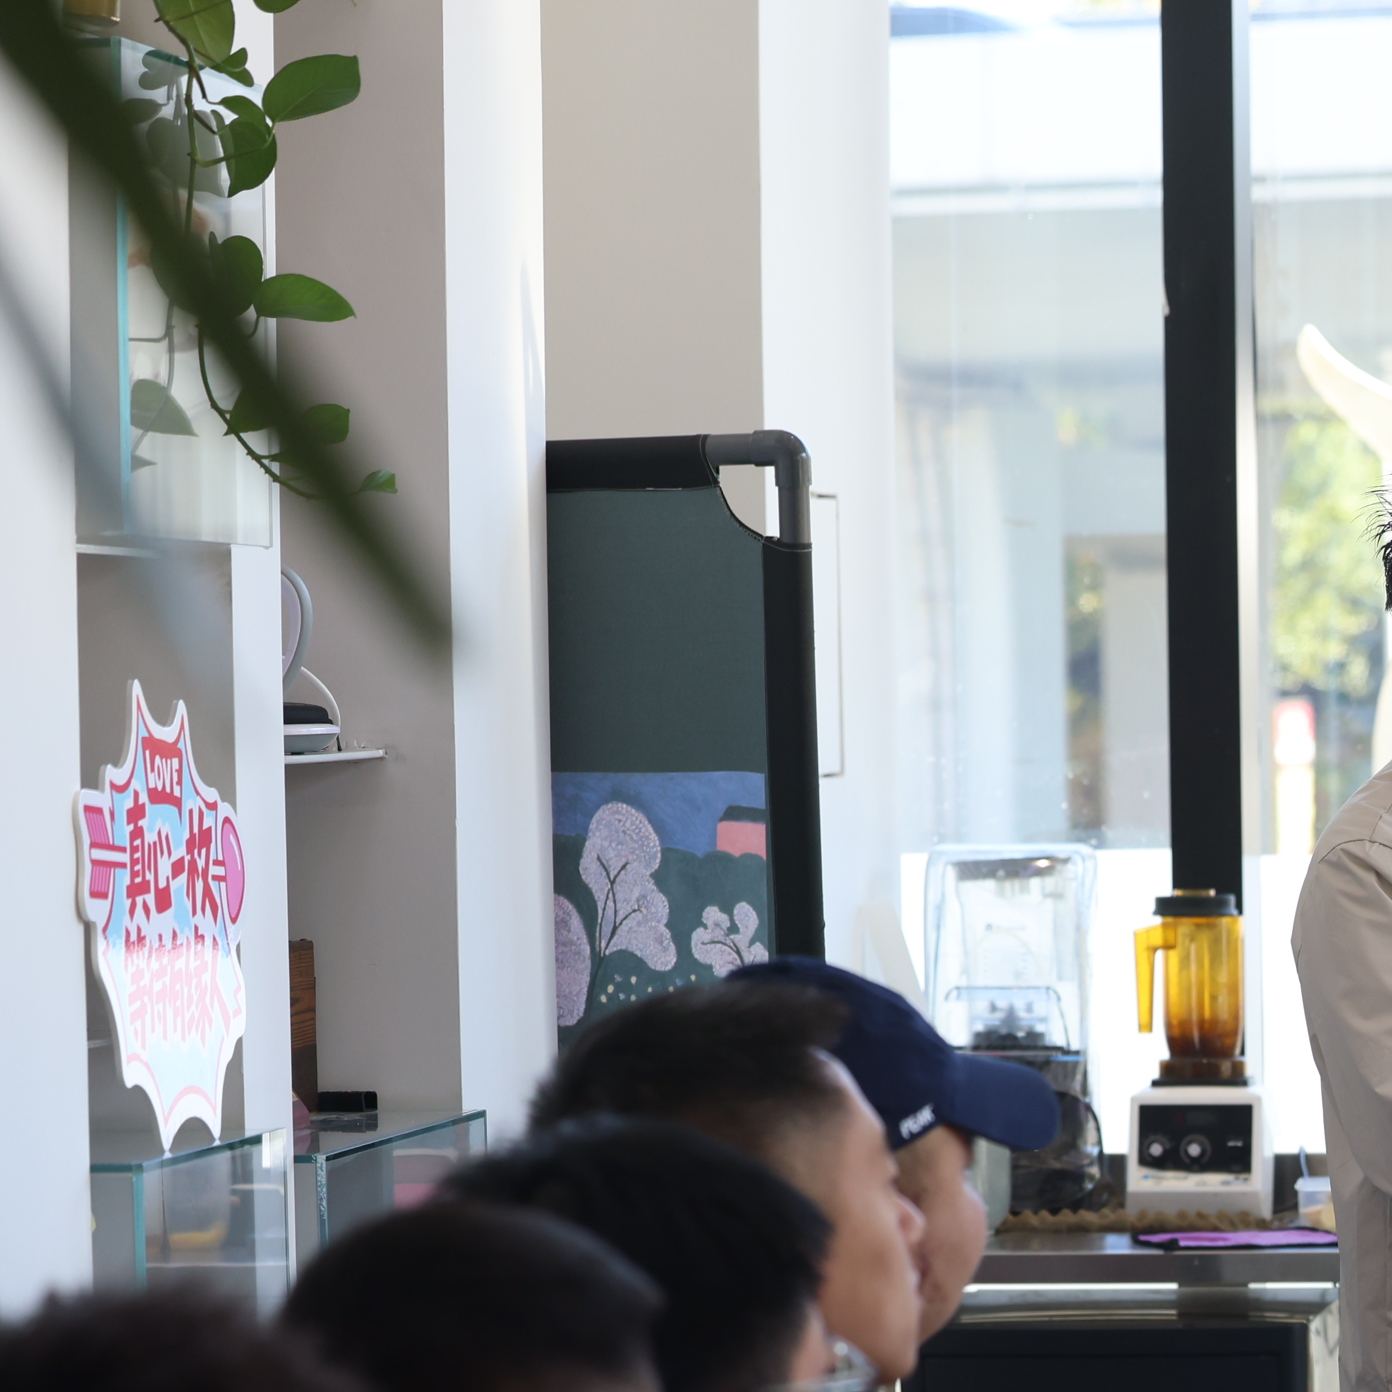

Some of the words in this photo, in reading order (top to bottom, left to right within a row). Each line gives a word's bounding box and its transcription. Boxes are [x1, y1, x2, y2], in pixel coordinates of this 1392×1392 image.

[145, 750, 180, 797] LOVE
[126, 788, 219, 926] 真心一枚
[124, 923, 231, 1051] 等待有缘人
